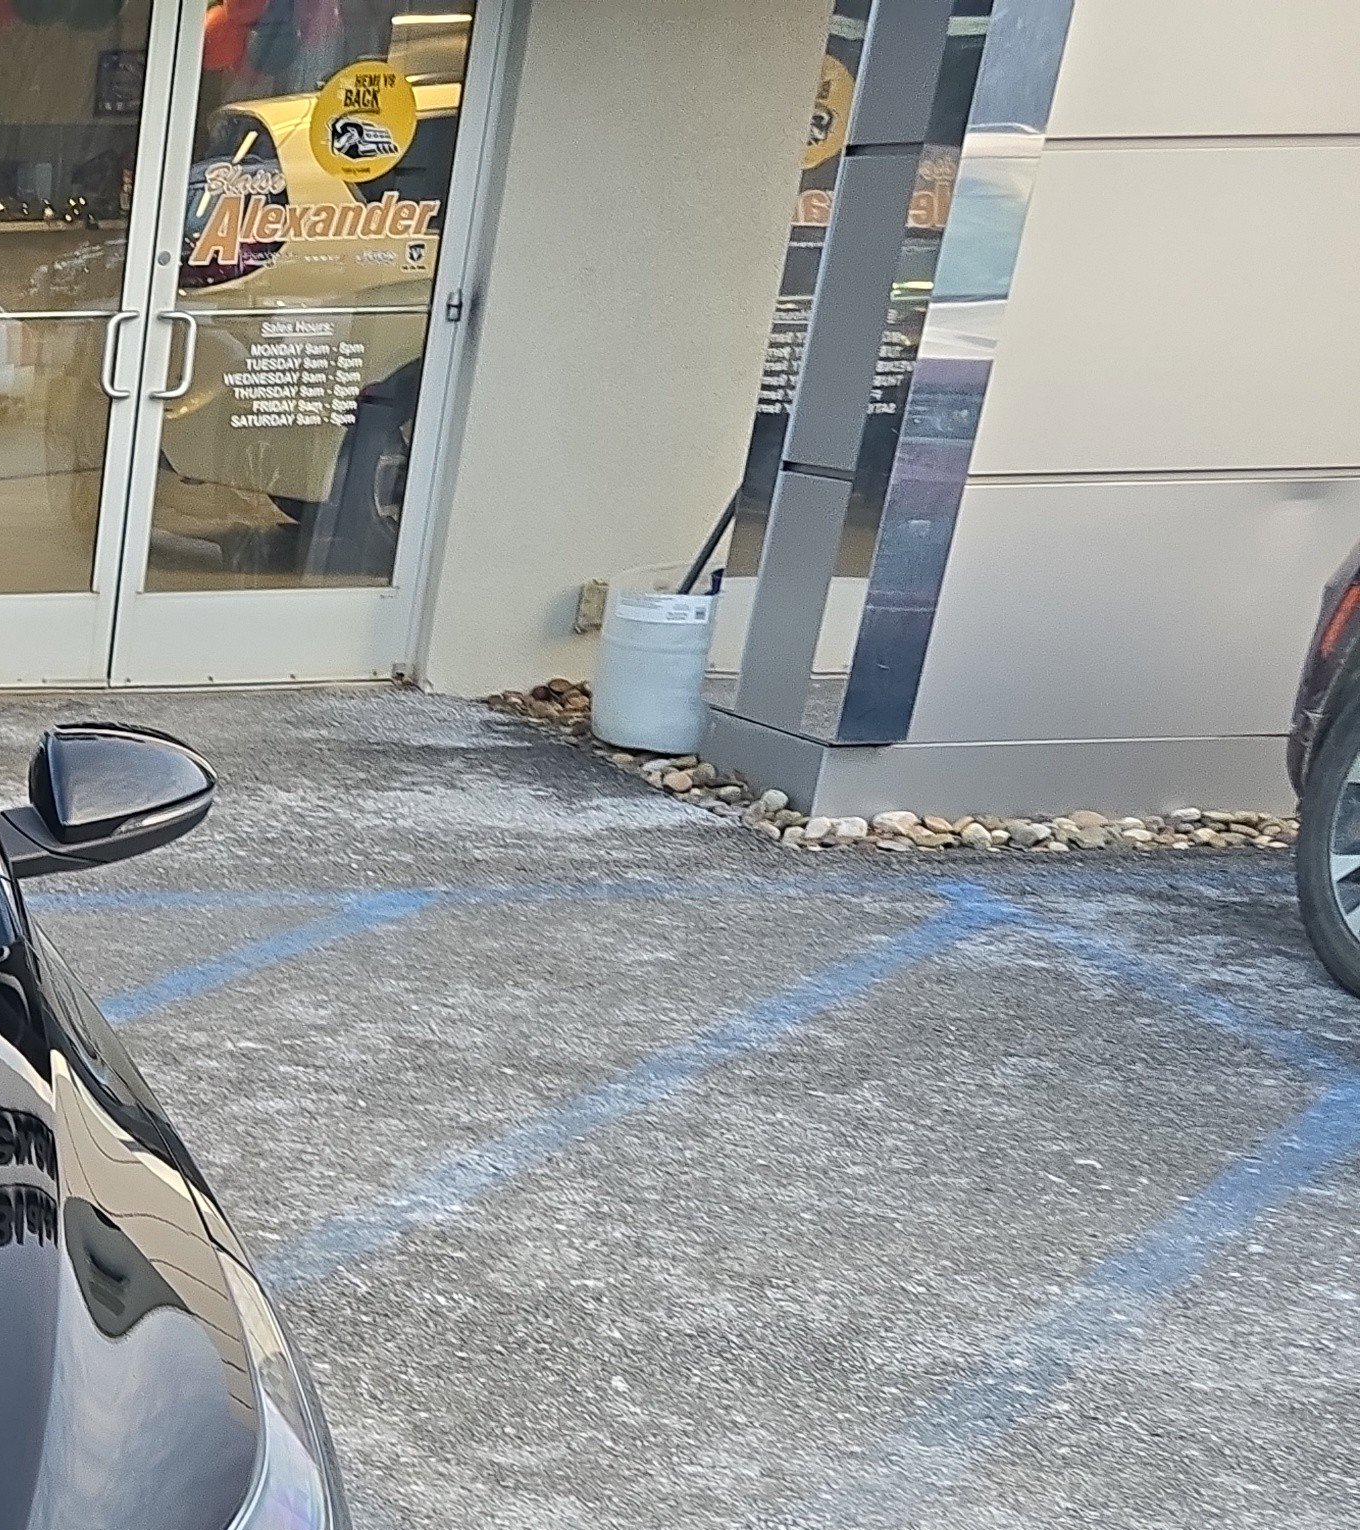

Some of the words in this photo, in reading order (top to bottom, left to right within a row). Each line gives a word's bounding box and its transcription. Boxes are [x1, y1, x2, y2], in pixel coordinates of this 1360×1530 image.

[343, 88, 380, 109] BACK
[188, 190, 441, 266] Alexander
[261, 321, 293, 335] Sales
[251, 343, 304, 357] MONDAY
[245, 357, 302, 371] TUESDAY
[223, 371, 300, 386] WEDNESDAY
[232, 385, 298, 400] THURSDAY
[252, 399, 297, 413] FRIDAY
[230, 413, 295, 428] SATURDAY
